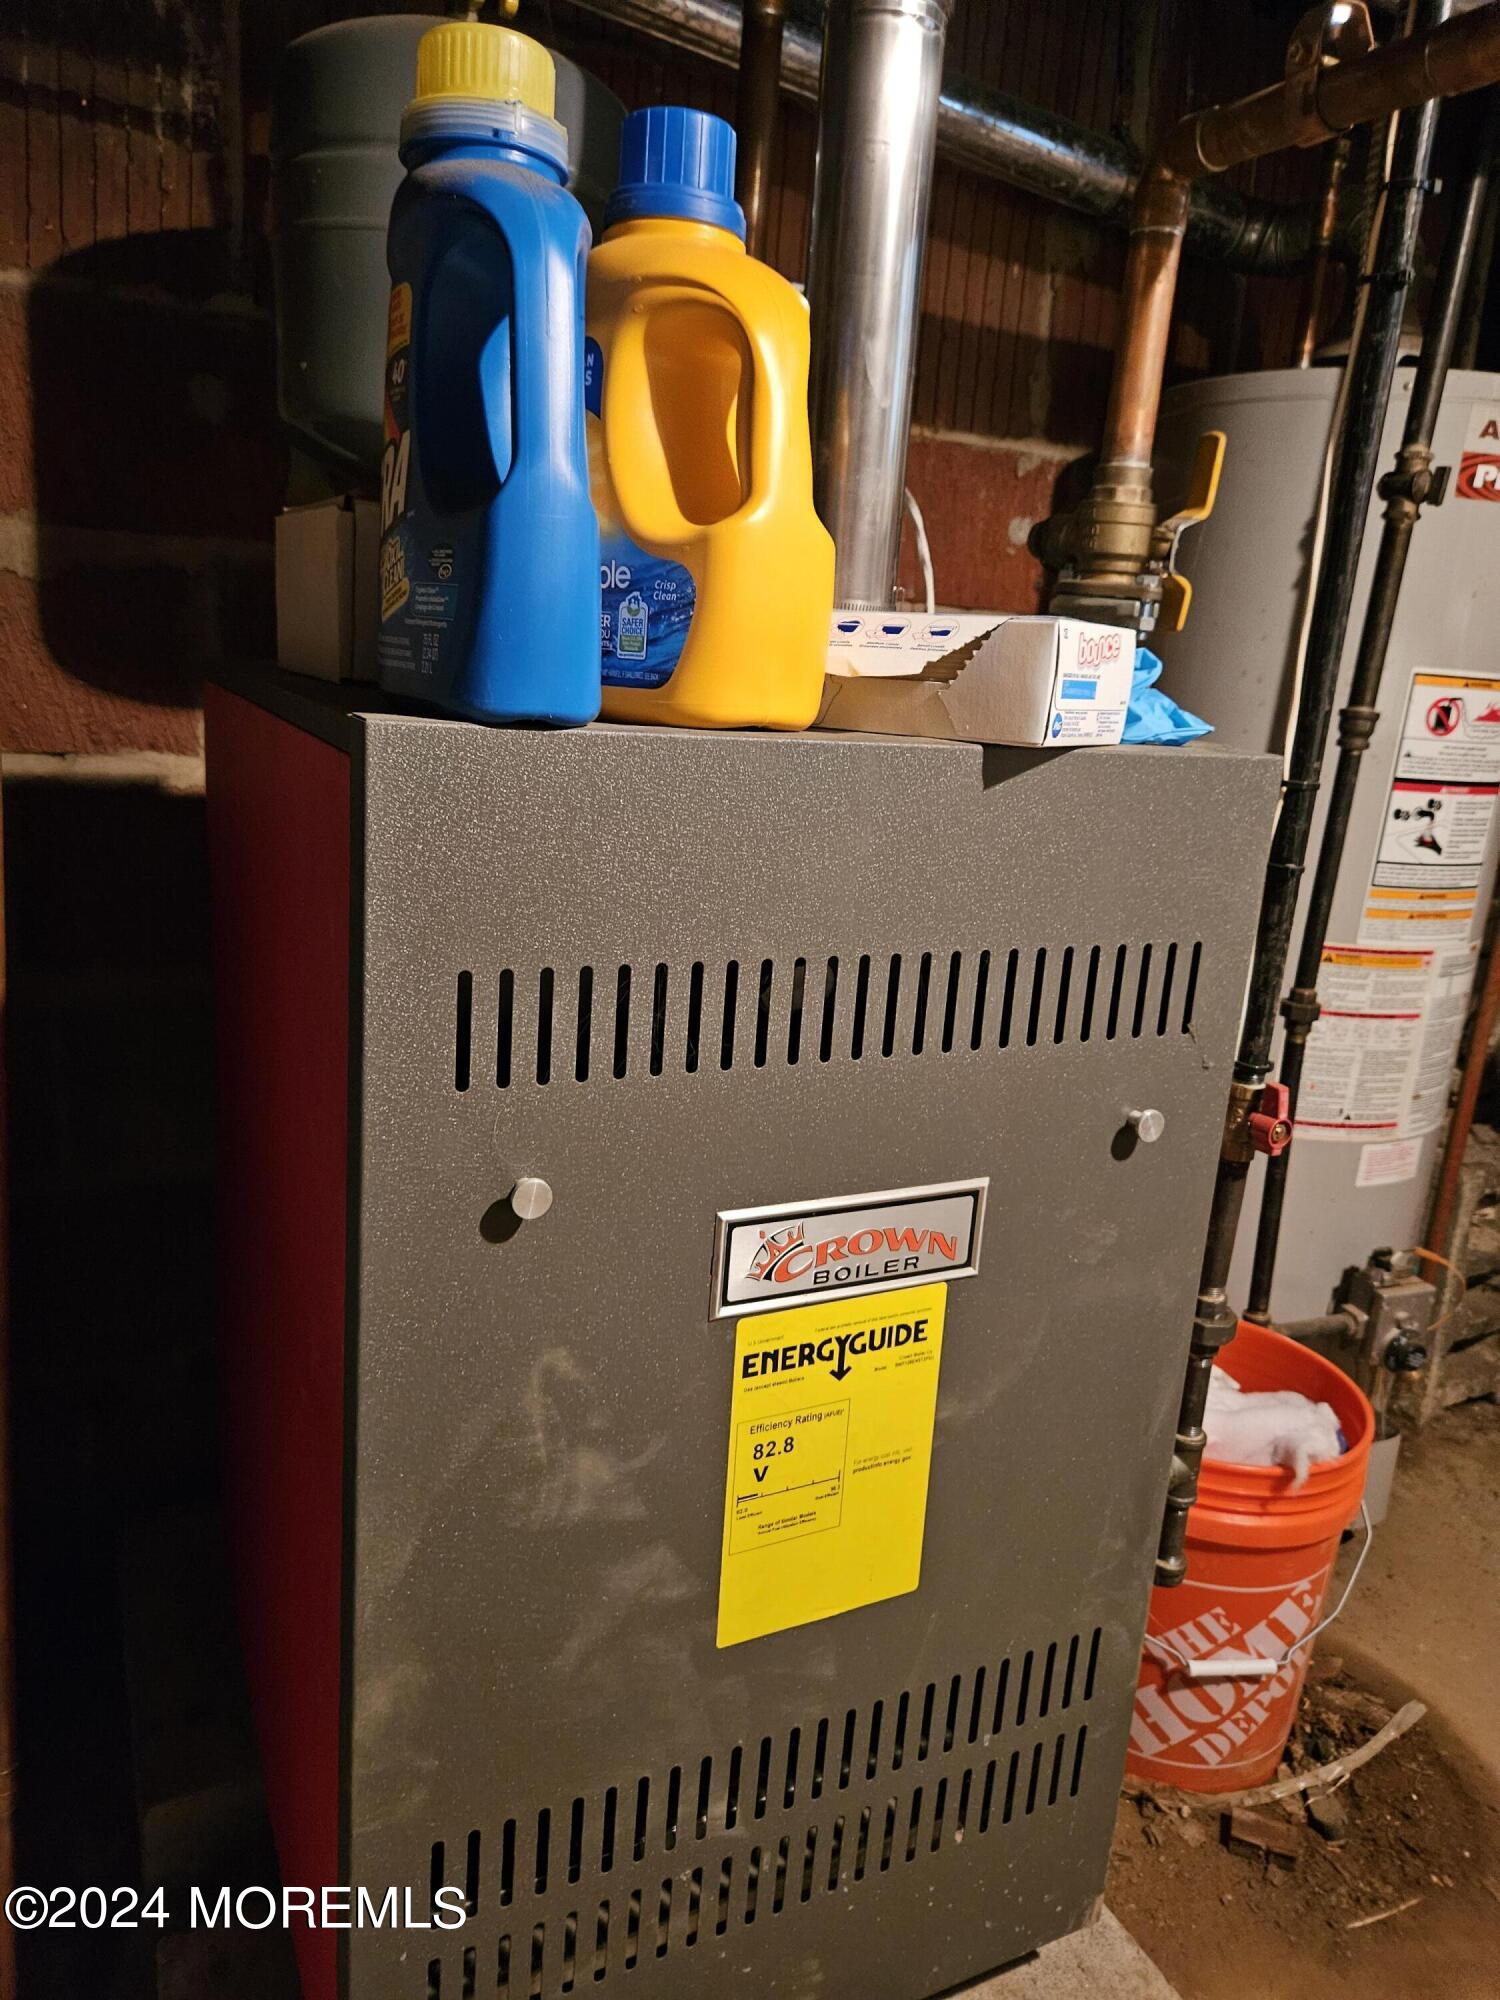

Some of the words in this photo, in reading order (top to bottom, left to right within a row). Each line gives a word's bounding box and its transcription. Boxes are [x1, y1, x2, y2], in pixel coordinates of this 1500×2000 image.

[653, 590, 677, 601] Clean
[654, 580, 677, 591] Crisp
[622, 616, 644, 628] SAFER
[772, 1227, 958, 1284] CROWN
[813, 1256, 920, 1285] BOILER
[742, 1319, 929, 1381] ENERGYGUIDE
[750, 1418, 793, 1435] Efficiency
[795, 1412, 823, 1425] Rating
[753, 1436, 795, 1461] 82.8
